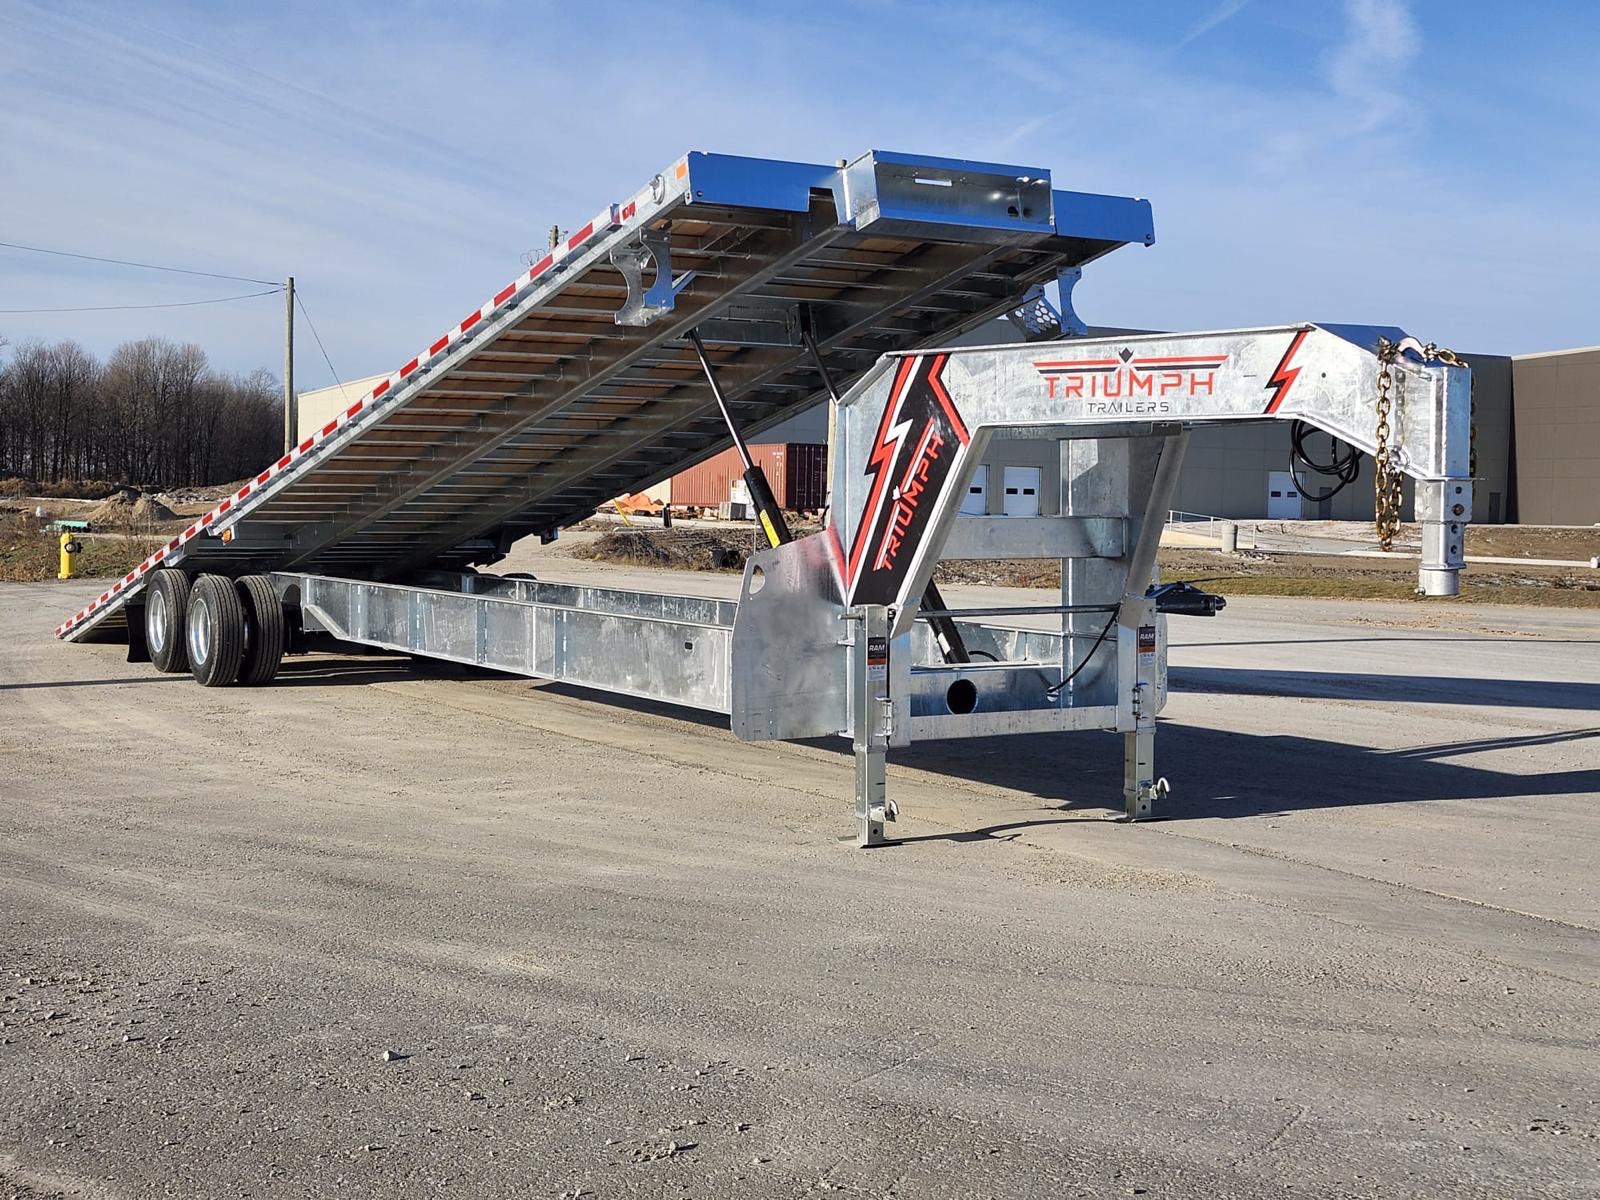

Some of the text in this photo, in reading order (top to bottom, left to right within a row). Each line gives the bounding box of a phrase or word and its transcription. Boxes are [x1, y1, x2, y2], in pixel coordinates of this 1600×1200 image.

[1044, 368, 1215, 400] TRIUMPH
[1087, 401, 1169, 413] TRAILERS
[882, 434, 945, 571] TRIUMPH
[868, 644, 886, 652] RAM
